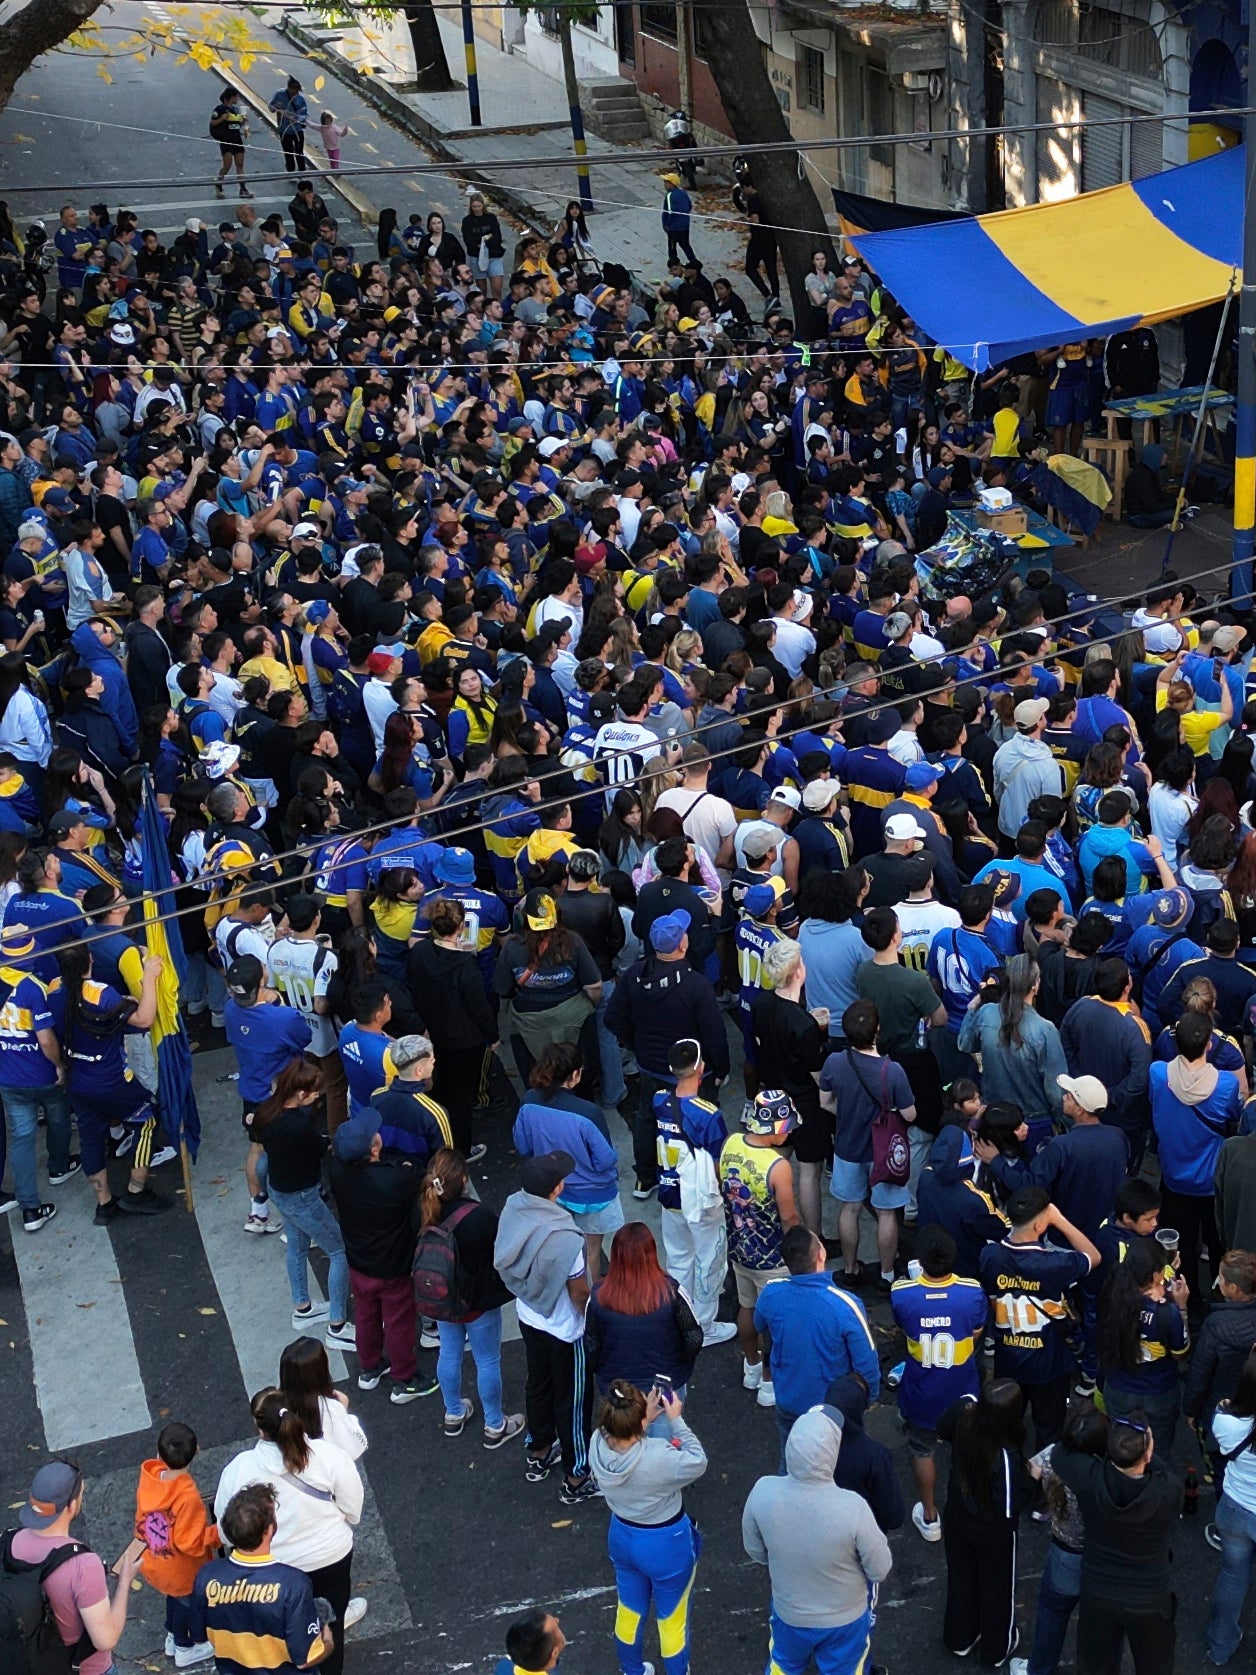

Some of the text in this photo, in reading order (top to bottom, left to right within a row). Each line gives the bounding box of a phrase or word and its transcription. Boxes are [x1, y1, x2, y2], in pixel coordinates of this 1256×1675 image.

[602, 750, 635, 787] 10
[937, 946, 974, 995] 10
[278, 974, 314, 1013] 10
[920, 1315, 952, 1328] ROMERO
[919, 1332, 955, 1369] 10
[205, 1579, 281, 1607] Quilmes
